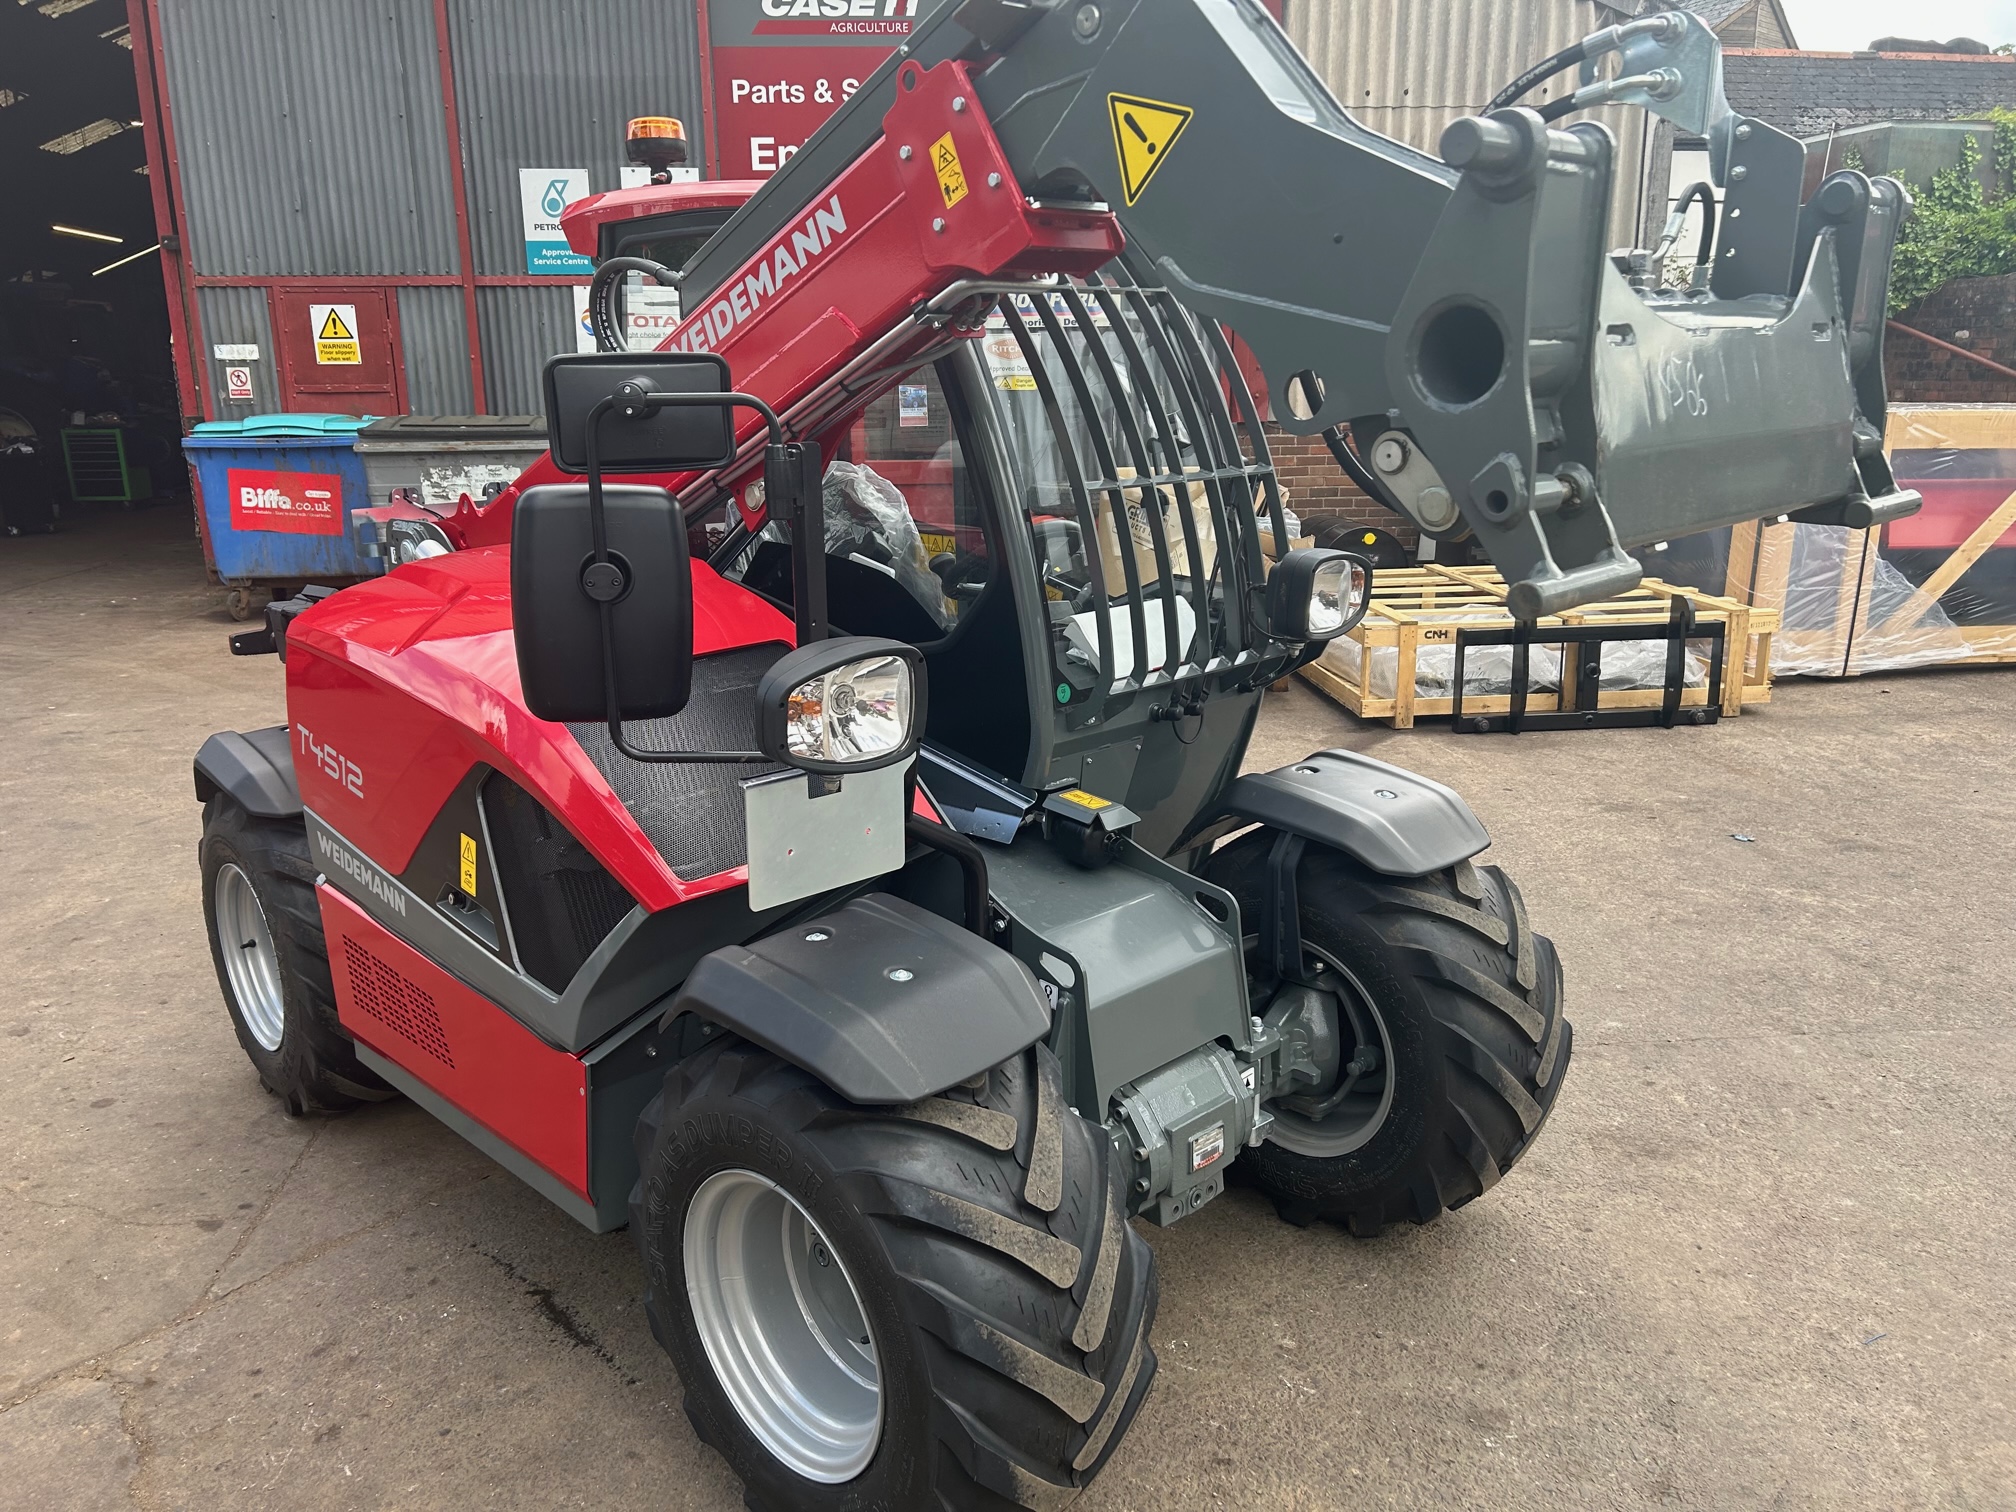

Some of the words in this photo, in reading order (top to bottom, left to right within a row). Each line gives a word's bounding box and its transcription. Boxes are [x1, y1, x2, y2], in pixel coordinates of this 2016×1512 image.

[830, 22, 909, 33] AGRICULTURE
[731, 79, 806, 104] Parts
[813, 78, 834, 104] &
[534, 223, 564, 231] PETRO
[541, 248, 579, 257] Approve
[533, 257, 562, 265] Service
[562, 257, 589, 265] Centre
[622, 313, 680, 328] TOTA
[992, 345, 1022, 353] RITCH
[240, 487, 332, 512] Biffa.co.uk
[1424, 629, 1448, 640] CNH
[297, 723, 364, 799] T4512
[316, 830, 407, 917] WEIDEMANN
[682, 1111, 794, 1181] DUMPER
